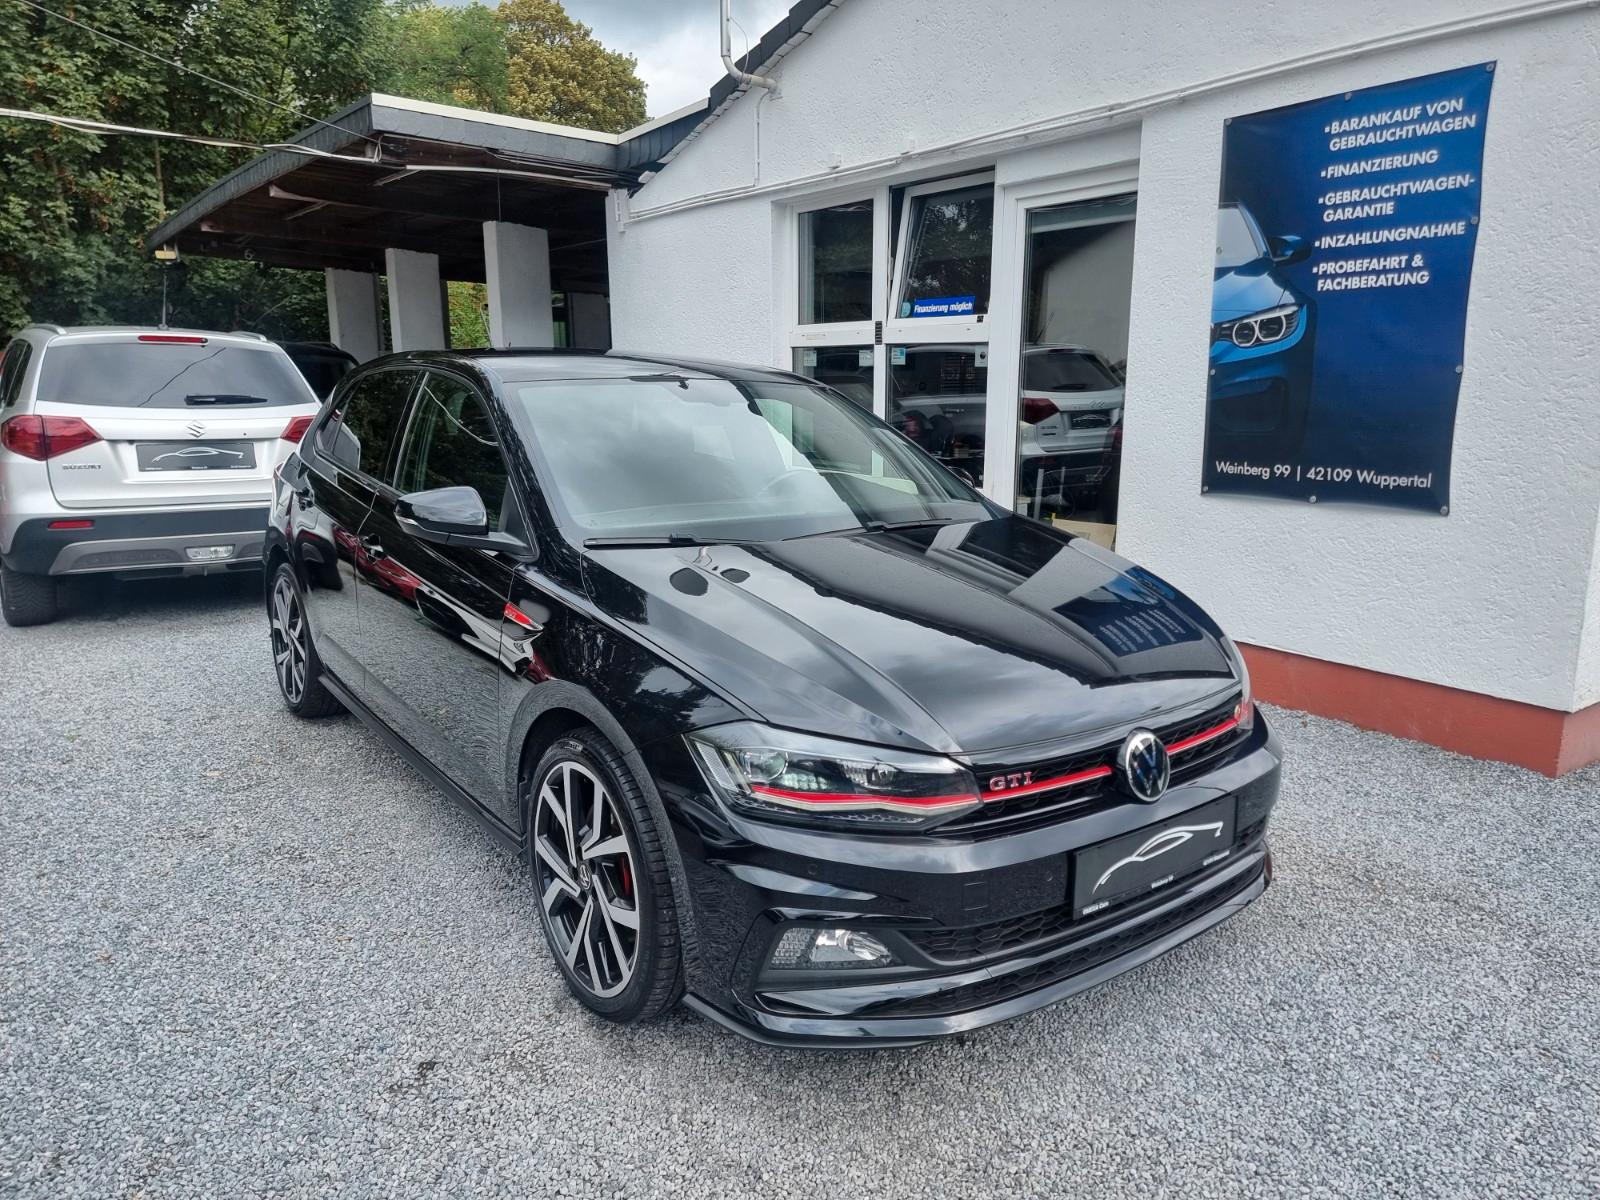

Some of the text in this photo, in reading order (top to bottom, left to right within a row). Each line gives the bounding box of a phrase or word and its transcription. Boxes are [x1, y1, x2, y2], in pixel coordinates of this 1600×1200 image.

[1331, 98, 1464, 134] BARANKAUF VON
[1330, 115, 1476, 151] GEBRAUCHTWAGEN
[1327, 150, 1439, 179] FINANZIERUNG
[1325, 174, 1476, 205] GEBRAUCHTWAGEN-
[1323, 202, 1395, 222] GARANTIE
[1321, 221, 1466, 249] INZAHLUNGNAHME
[1318, 254, 1424, 275] PROBEFAHRT &
[1317, 271, 1430, 292] FACHBERATUNG
[914, 302, 973, 314] Finanzierung möglich
[1215, 461, 1432, 489] Weinberg 99 42109 Wuppertal
[990, 771, 1033, 791] GTI
